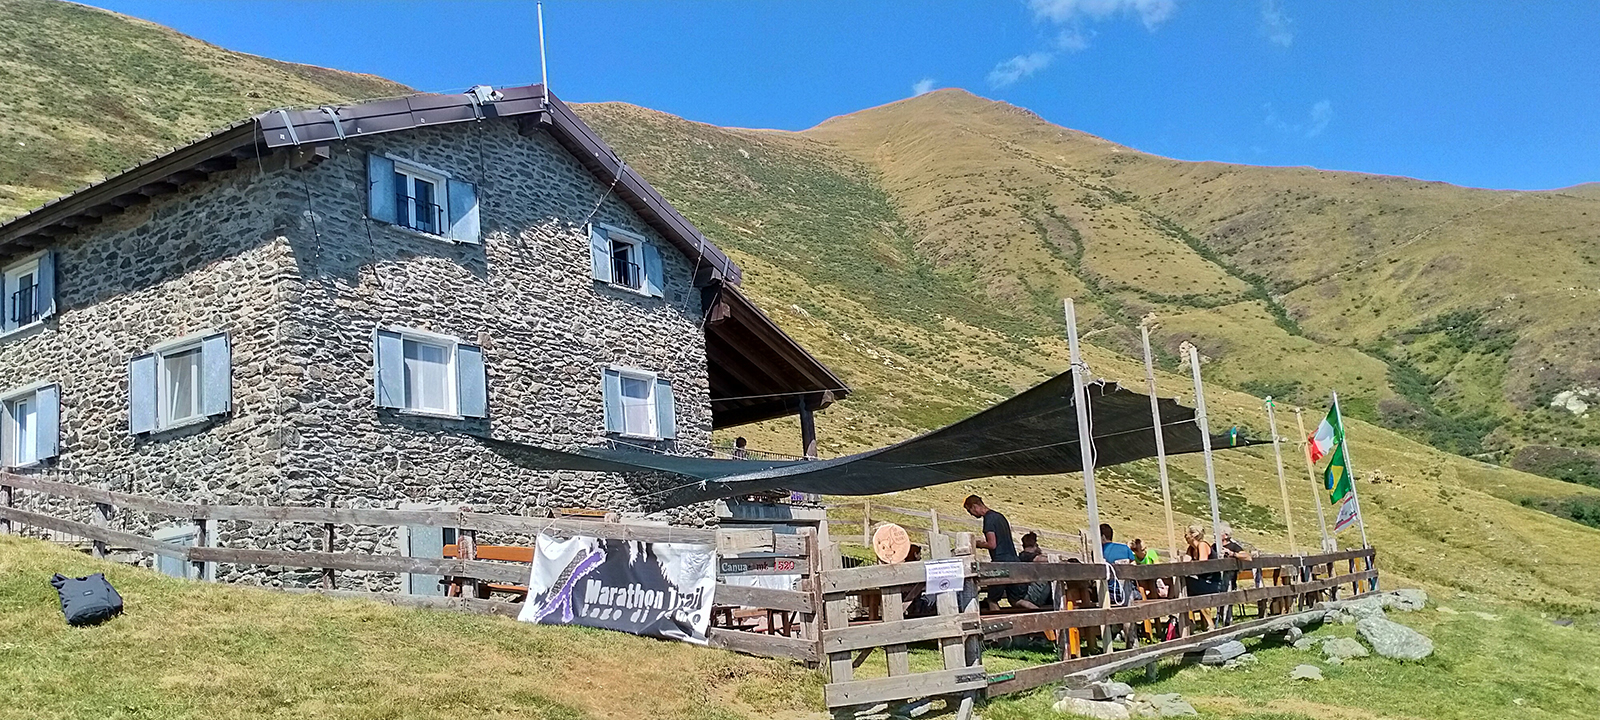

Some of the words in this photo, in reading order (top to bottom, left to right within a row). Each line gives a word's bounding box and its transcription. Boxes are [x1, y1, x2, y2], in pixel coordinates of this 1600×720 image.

[773, 560, 795, 572] 1520
[584, 579, 665, 609] Marathon
[667, 585, 705, 611] Trail
[630, 605, 650, 623] di
